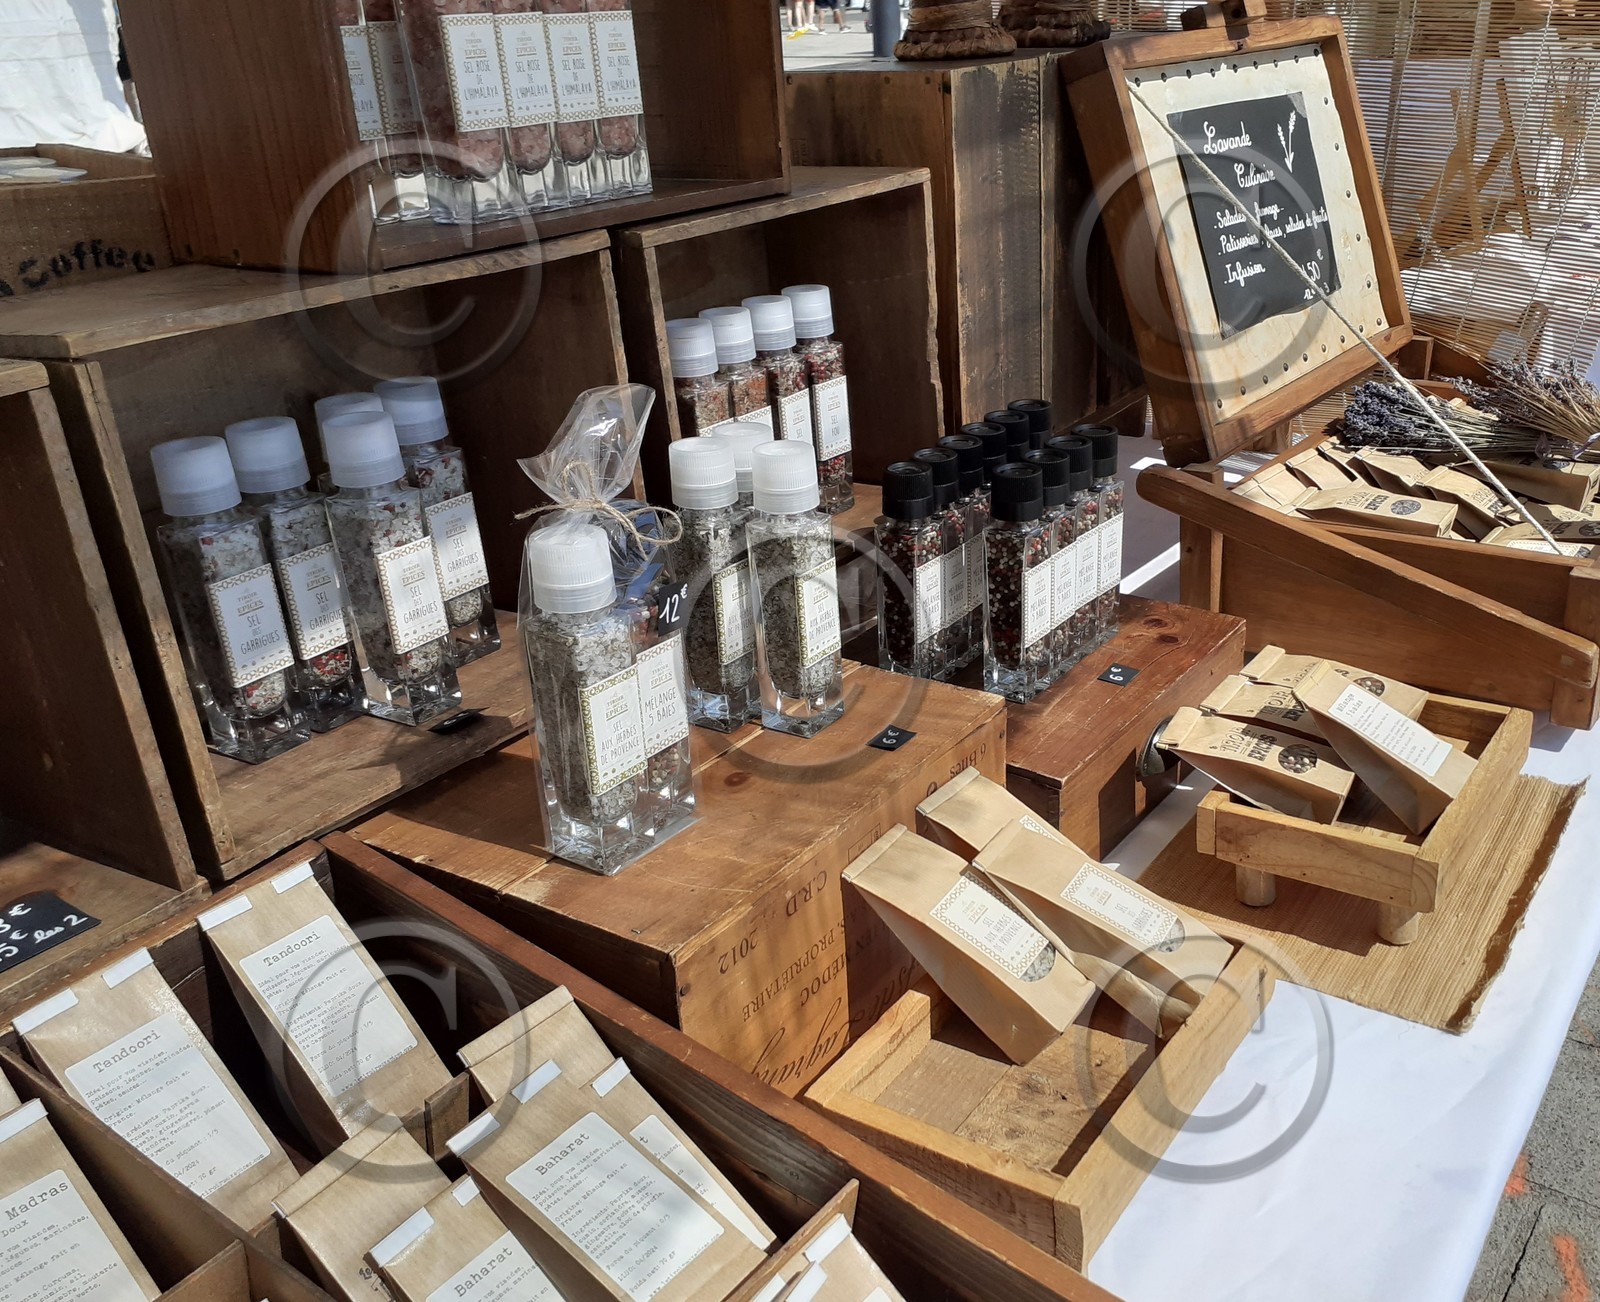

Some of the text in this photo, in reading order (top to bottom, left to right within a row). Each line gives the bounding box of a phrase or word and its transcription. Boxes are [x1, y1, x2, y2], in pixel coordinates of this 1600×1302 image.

[463, 60, 491, 74] SEL ROSE
[515, 59, 541, 73] SEL ROSE
[1203, 121, 1252, 154] Lavande
[1234, 163, 1276, 188] Culinaire
[1305, 212, 1313, 227] de
[1225, 261, 1266, 288] Infusion
[453, 537, 465, 550] SEL
[447, 551, 480, 573] GARRIGUES
[315, 591, 329, 605] SEL
[409, 585, 423, 599] SEL
[247, 613, 262, 628] SEL
[309, 606, 347, 631] GARRIGUES
[403, 600, 438, 624] GARRIGUES
[240, 630, 280, 655] GARRIGUES
[644, 686, 677, 714] MÉLANGE
[649, 702, 676, 727] 5 BAIES
[601, 724, 637, 753] AUX HERBES
[613, 720, 623, 734] SEL
[600, 736, 640, 766] DE PROVENCE
[62, 914, 89, 927] 2
[262, 930, 321, 967] Tandoori
[717, 926, 759, 976] 2012
[741, 927, 841, 1023] PROPRIÉTAIRE
[92, 1029, 161, 1074] Tandoori
[106, 1074, 123, 1088] pour
[534, 1132, 590, 1176] Baharat
[4, 1182, 69, 1221] Madras
[581, 1179, 607, 1200] Mélange
[0, 1219, 29, 1238] Doux
[42, 1215, 89, 1242] marinades,
[560, 1208, 585, 1228] France.
[571, 1205, 610, 1238] Ingrédients:
[22, 1224, 59, 1244] viandes,
[13, 1261, 49, 1283] Mélange
[50, 1249, 68, 1262] fait
[81, 1262, 118, 1286] moutarde
[453, 1247, 513, 1298] Baharat
[42, 1268, 81, 1291] Curcuma,
[75, 1283, 101, 1298] verte,
